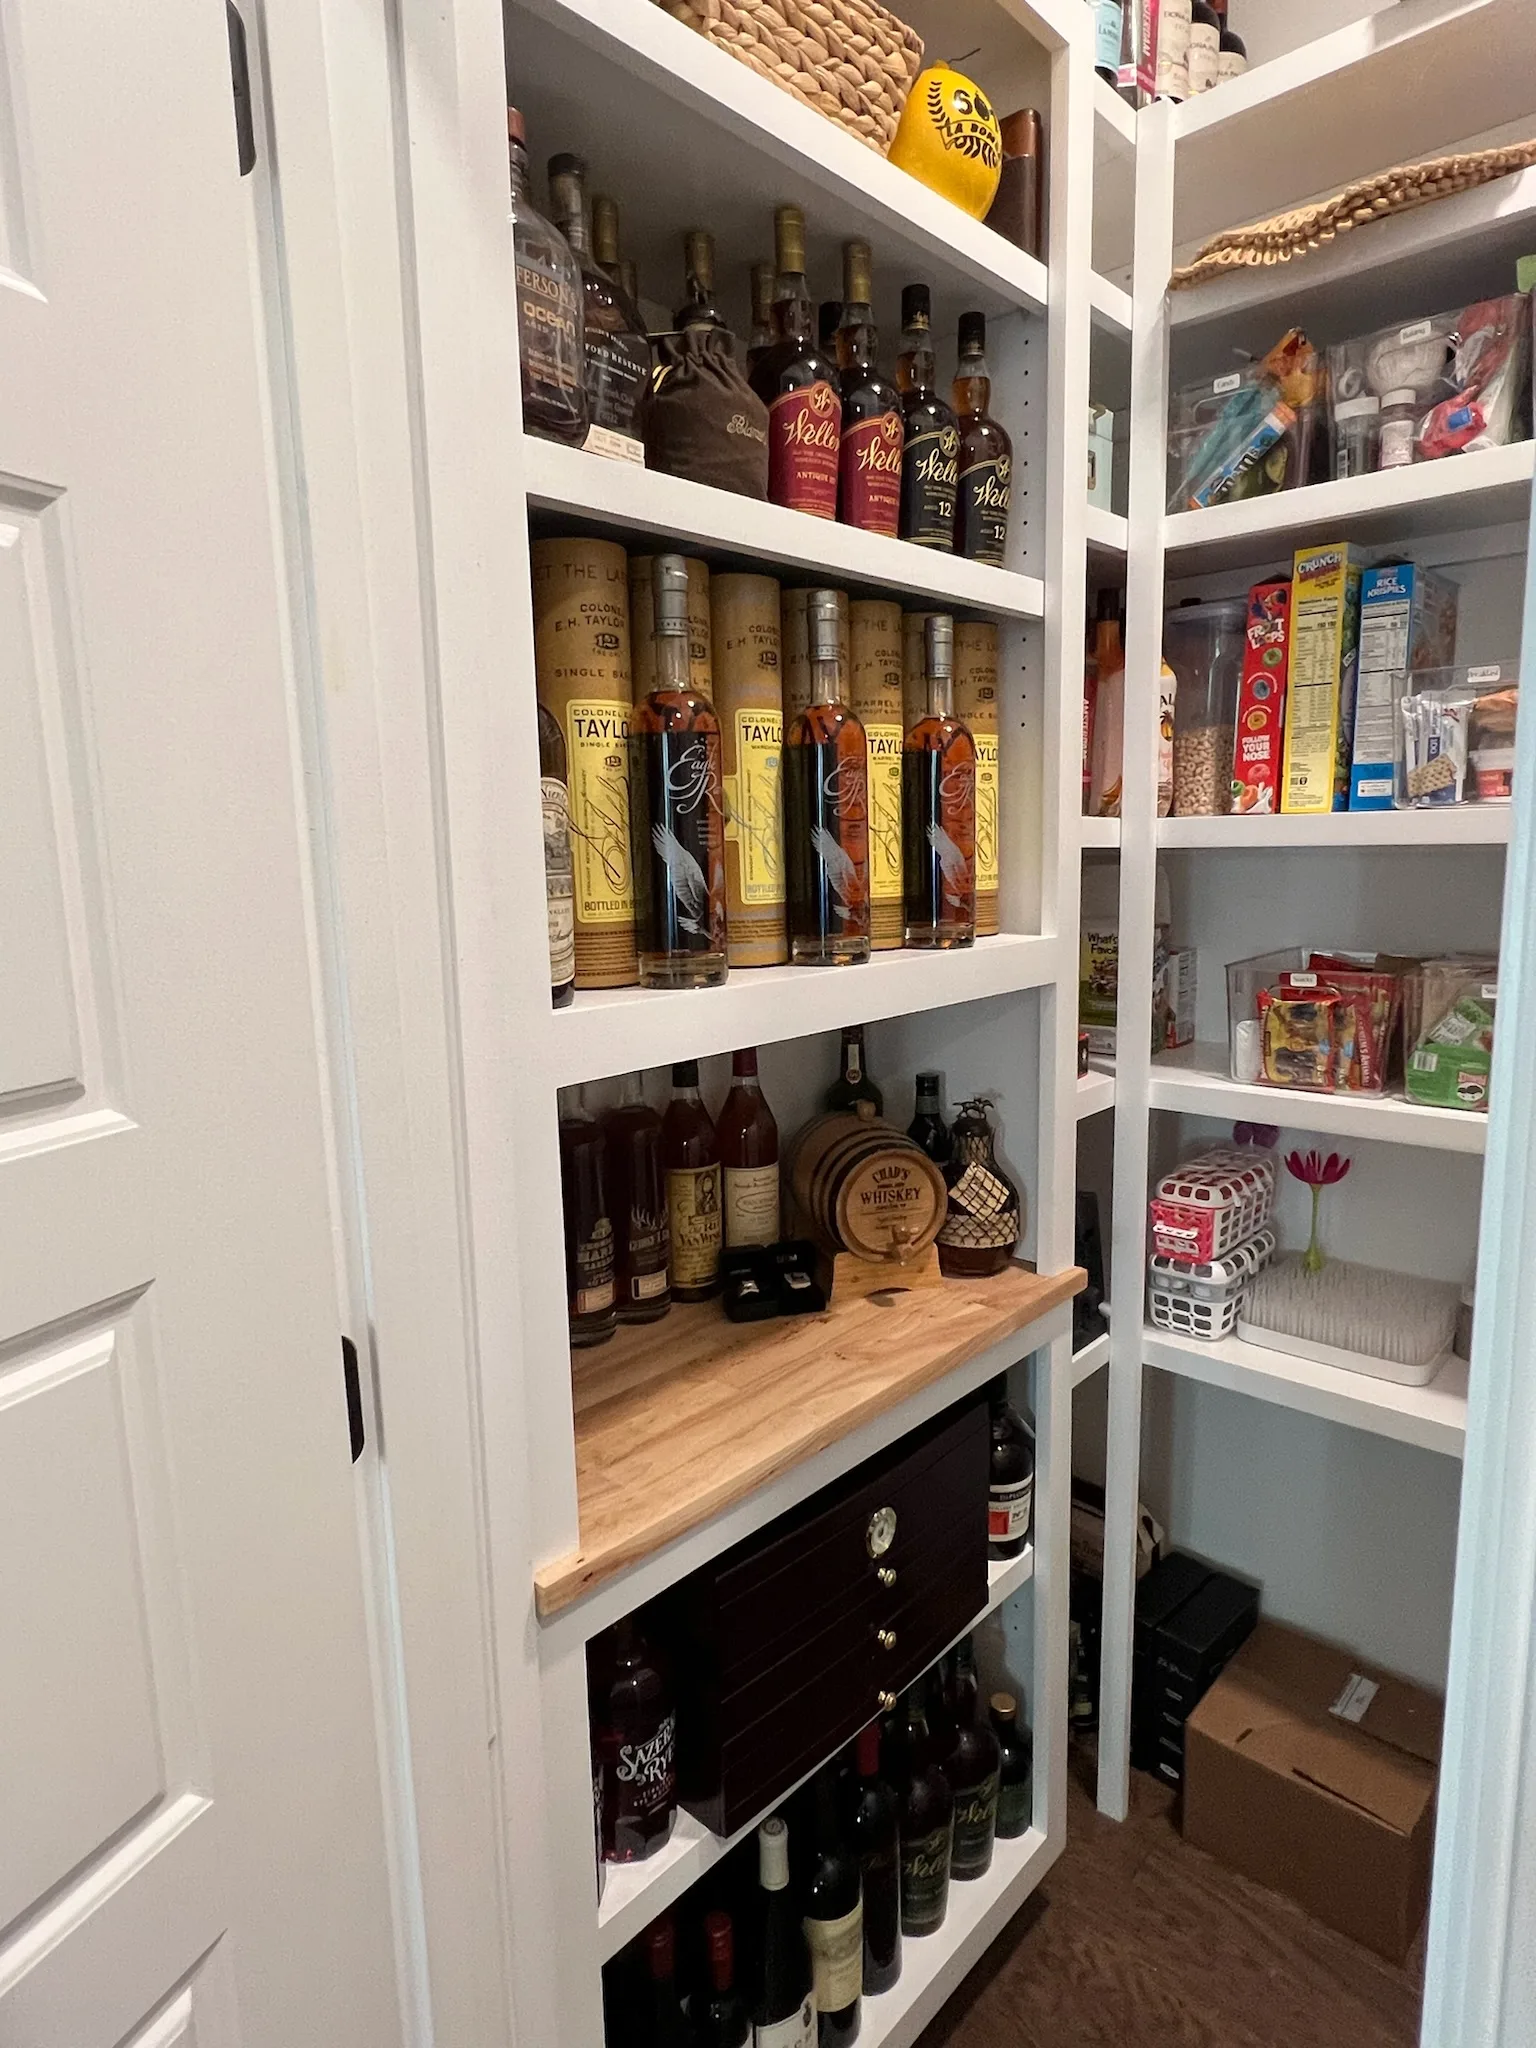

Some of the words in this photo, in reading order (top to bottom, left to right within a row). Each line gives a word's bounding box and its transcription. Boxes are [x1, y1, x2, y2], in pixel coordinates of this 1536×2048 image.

[939, 501, 951, 517] 12
[994, 525, 1005, 540] 12
[1298, 552, 1342, 574] CRUNCH
[562, 564, 597, 579] THE
[1376, 577, 1398, 588] RICE
[1367, 584, 1406, 598] KRISPIES
[555, 668, 605, 678] SINGLE
[574, 709, 622, 718] COLONEL
[1243, 742, 1270, 753] YOUR
[1243, 752, 1270, 762] NOSE
[584, 900, 619, 911] BOTTLED
[872, 1166, 911, 1183] CHAD'S
[861, 1187, 920, 1204] WHISKEY
